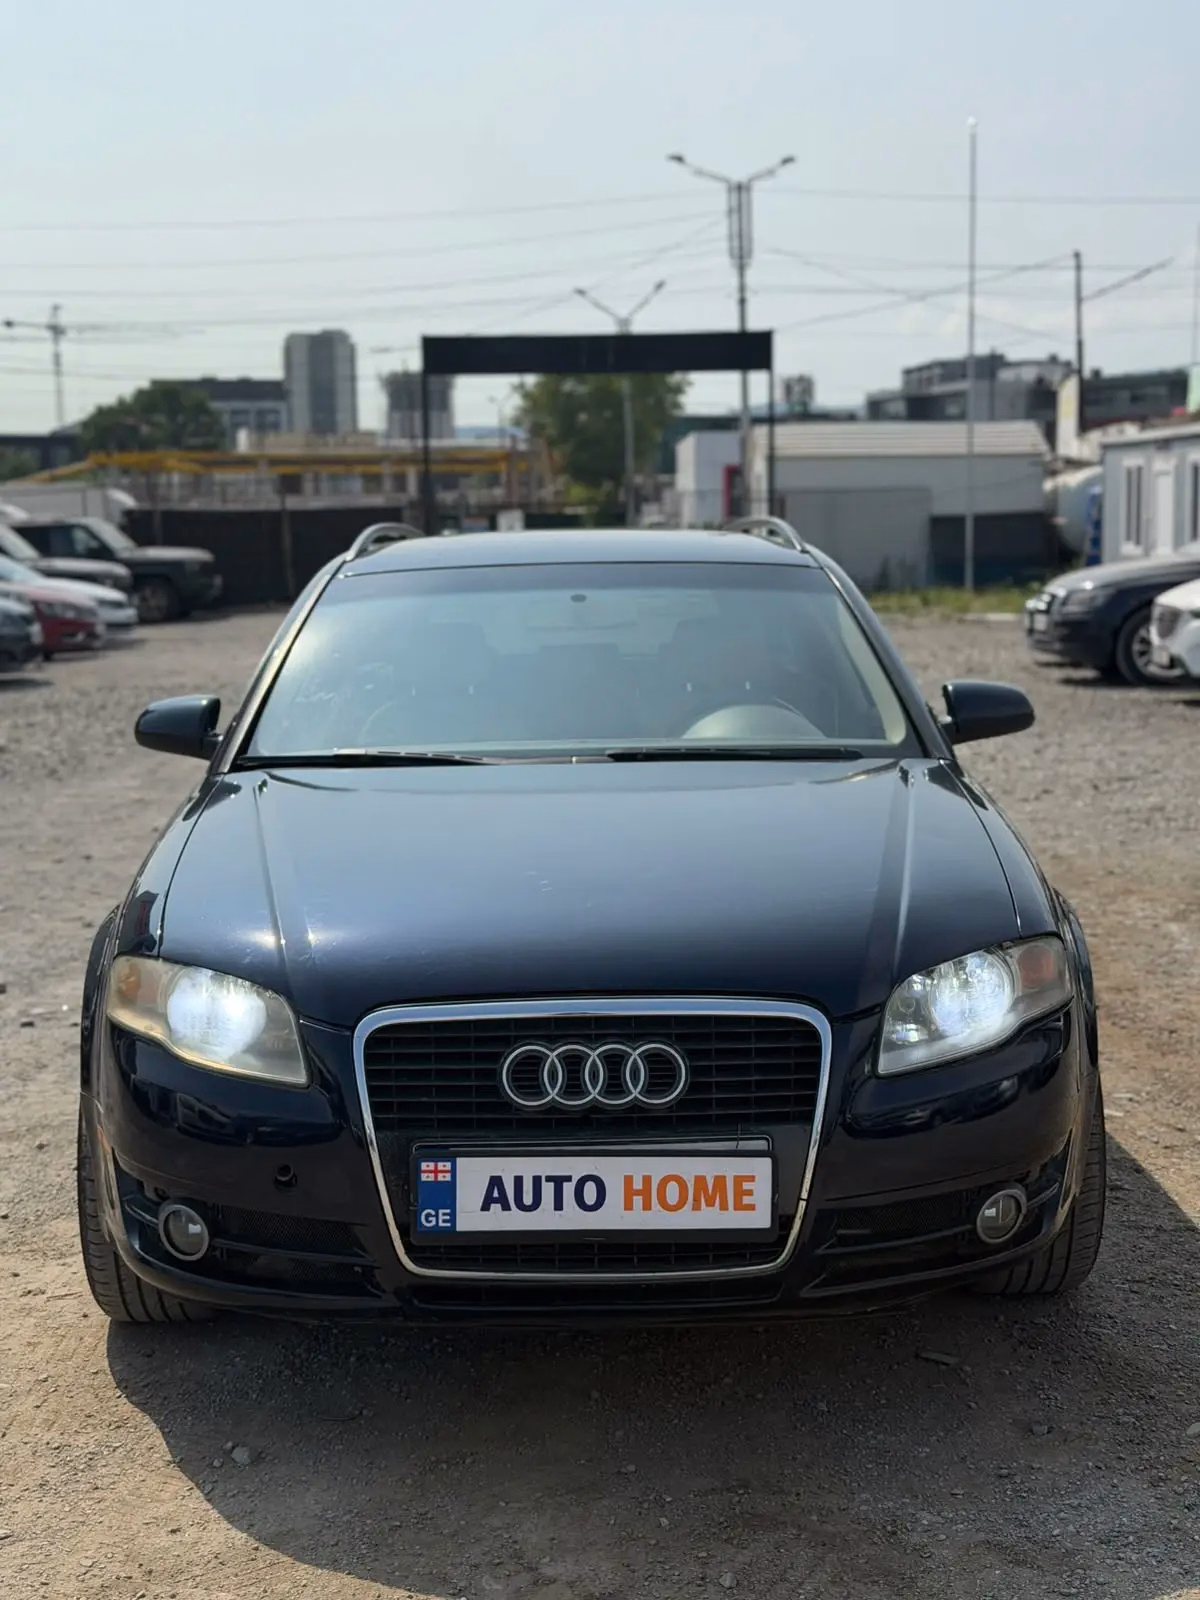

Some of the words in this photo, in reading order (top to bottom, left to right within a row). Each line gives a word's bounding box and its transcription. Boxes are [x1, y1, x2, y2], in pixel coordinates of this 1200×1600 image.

[480, 1174, 607, 1212] AUTO
[623, 1174, 757, 1212] HOME
[420, 1209, 451, 1227] GE
